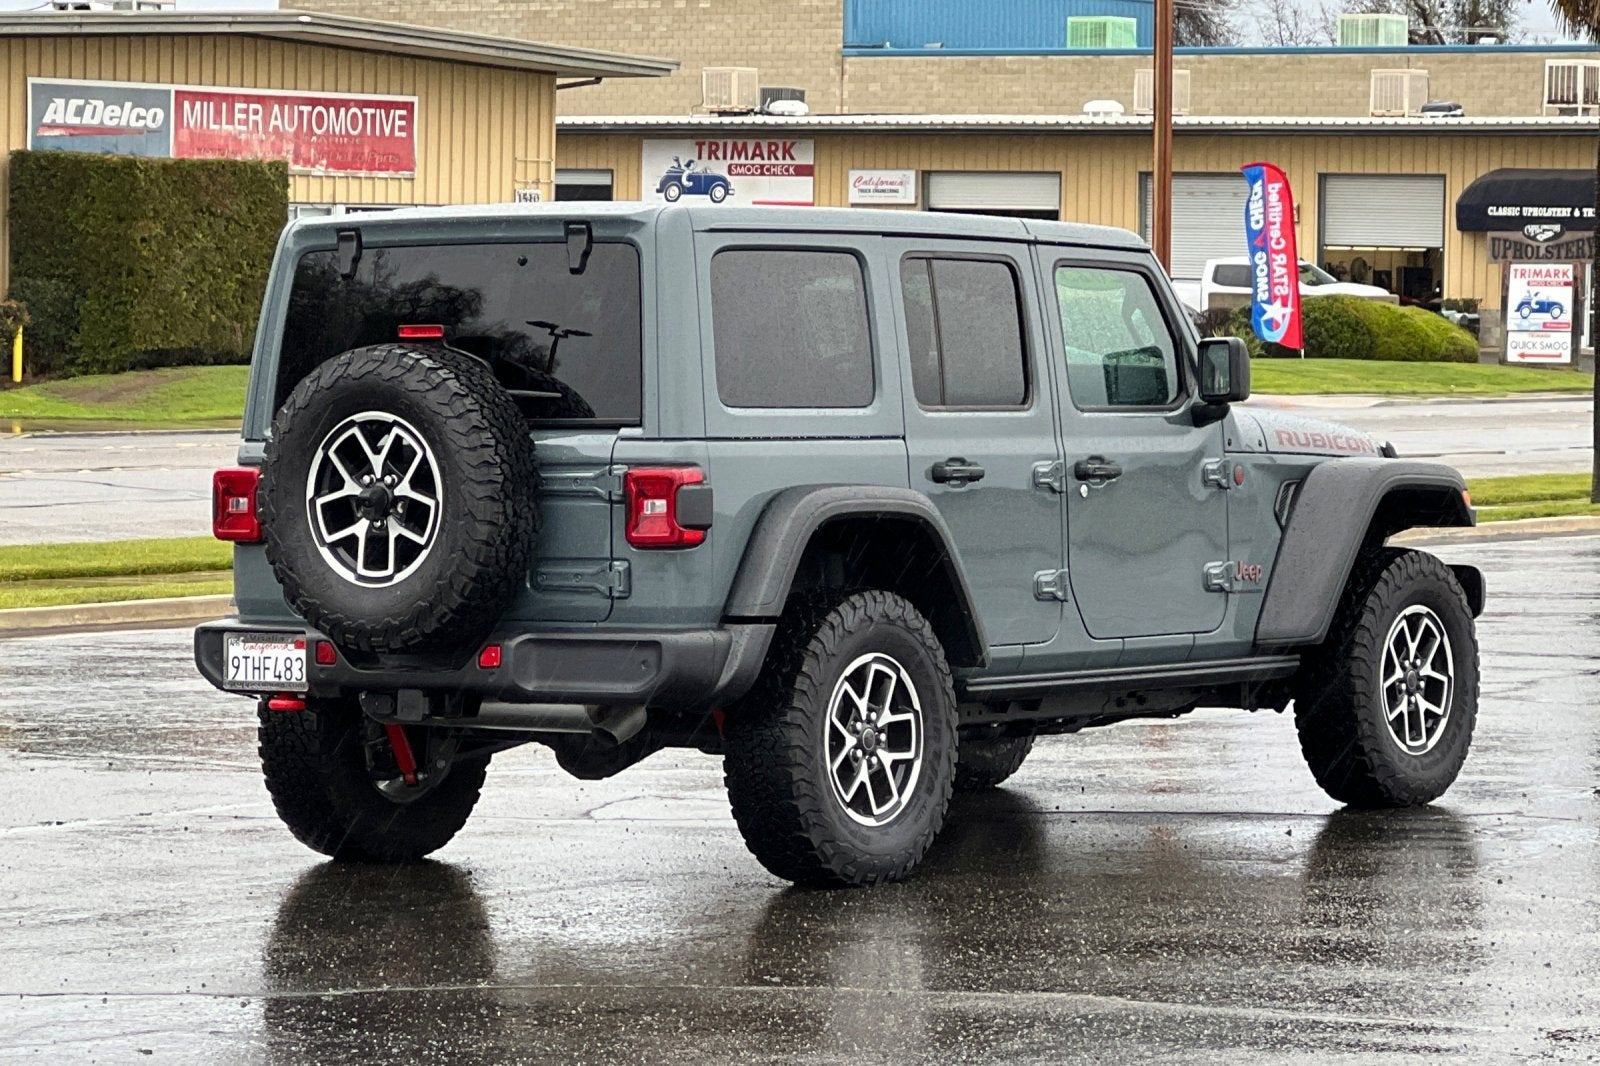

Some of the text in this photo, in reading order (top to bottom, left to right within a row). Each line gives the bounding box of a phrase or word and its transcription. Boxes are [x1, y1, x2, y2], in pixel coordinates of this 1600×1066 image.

[42, 98, 164, 129] ACDelco
[183, 100, 408, 137] MILLER AUTOMOTIVE
[695, 141, 796, 161] TRIMARK
[731, 164, 796, 175] SMOG CHECK
[853, 175, 904, 189] California
[1487, 206, 1520, 217] CLASSIC
[1522, 207, 1572, 217] UPHOLSTERY
[1573, 207, 1580, 217] &
[1513, 268, 1570, 279] TRIMARK
[1510, 340, 1568, 350] QUICK SMOG
[1274, 430, 1376, 453] RUBICON
[1234, 560, 1263, 583] Jeep
[231, 656, 304, 681] 9THF483
